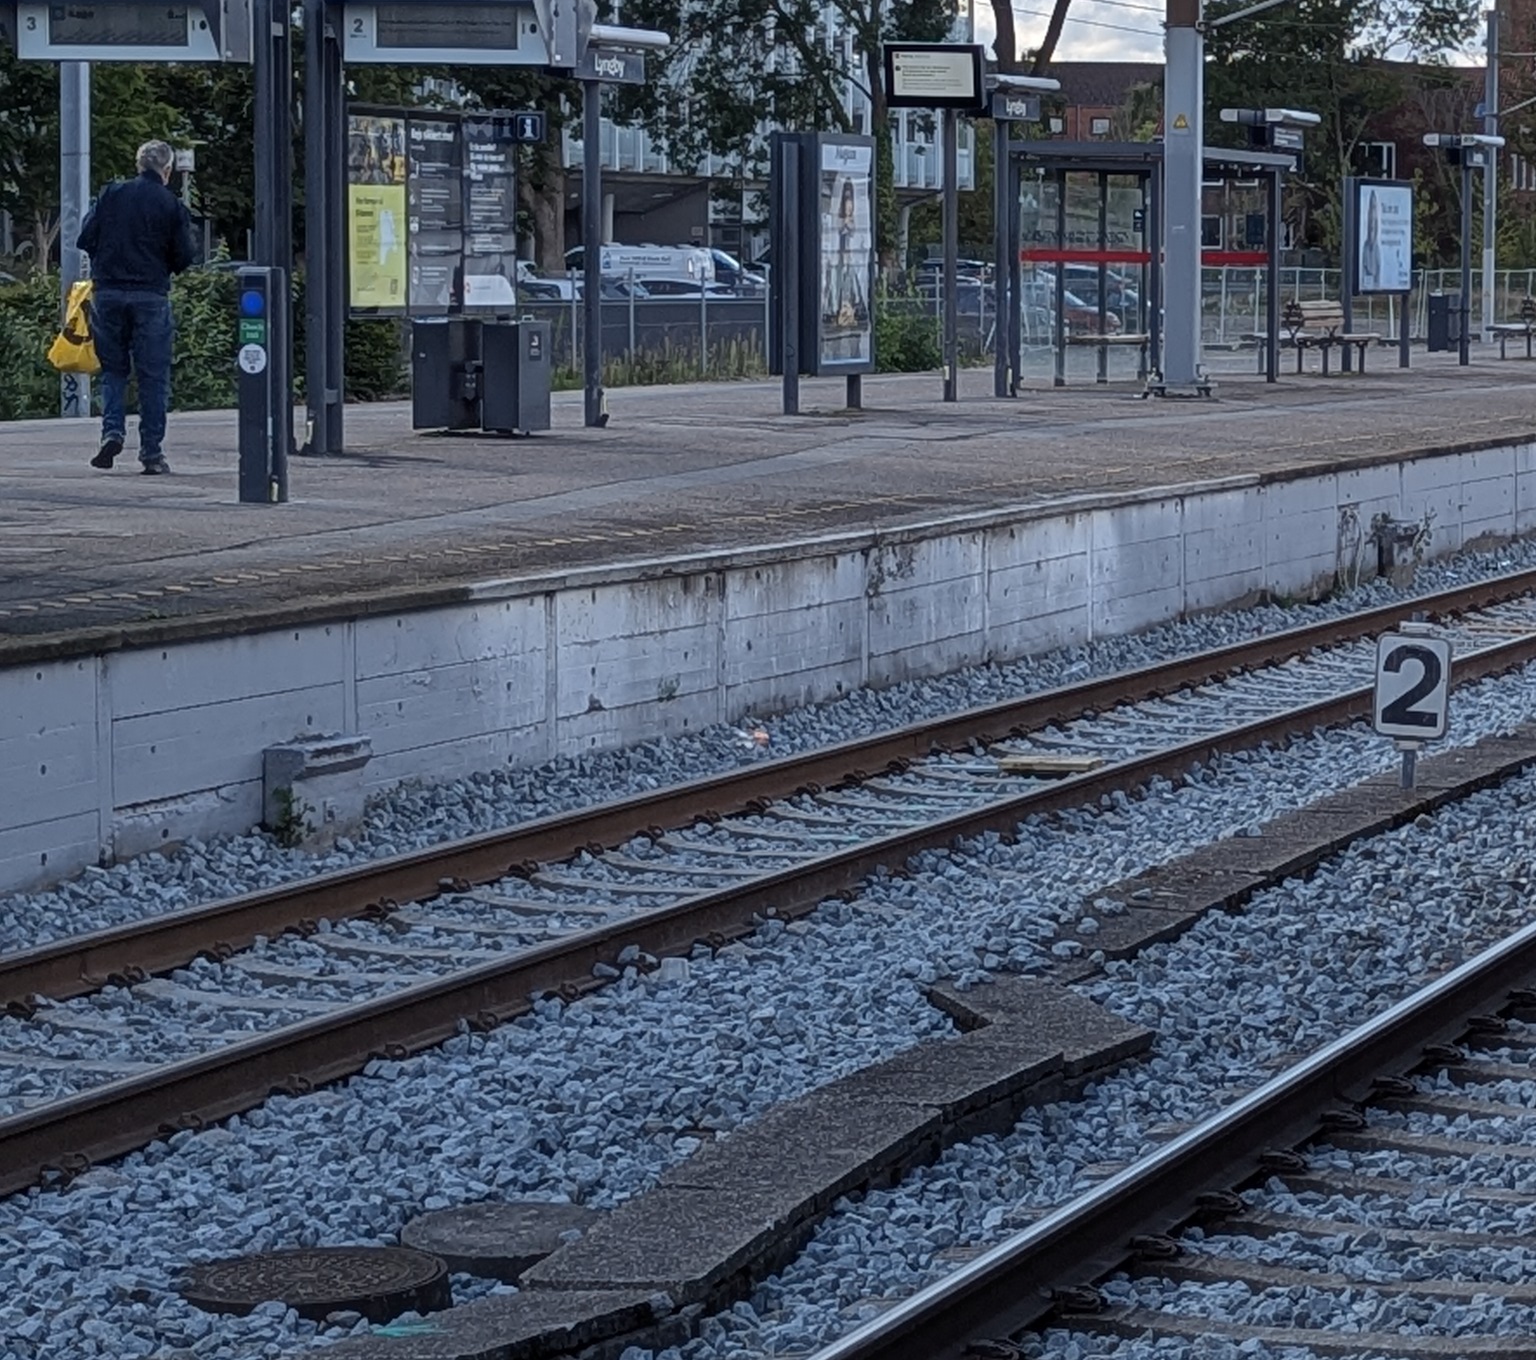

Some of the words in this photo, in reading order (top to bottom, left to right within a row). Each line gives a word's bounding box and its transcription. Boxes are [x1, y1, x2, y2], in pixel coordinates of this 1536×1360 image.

[27, 16, 37, 31] 3
[353, 18, 364, 33] 2
[594, 53, 626, 79] Lyngby
[1381, 645, 1441, 728] 2
